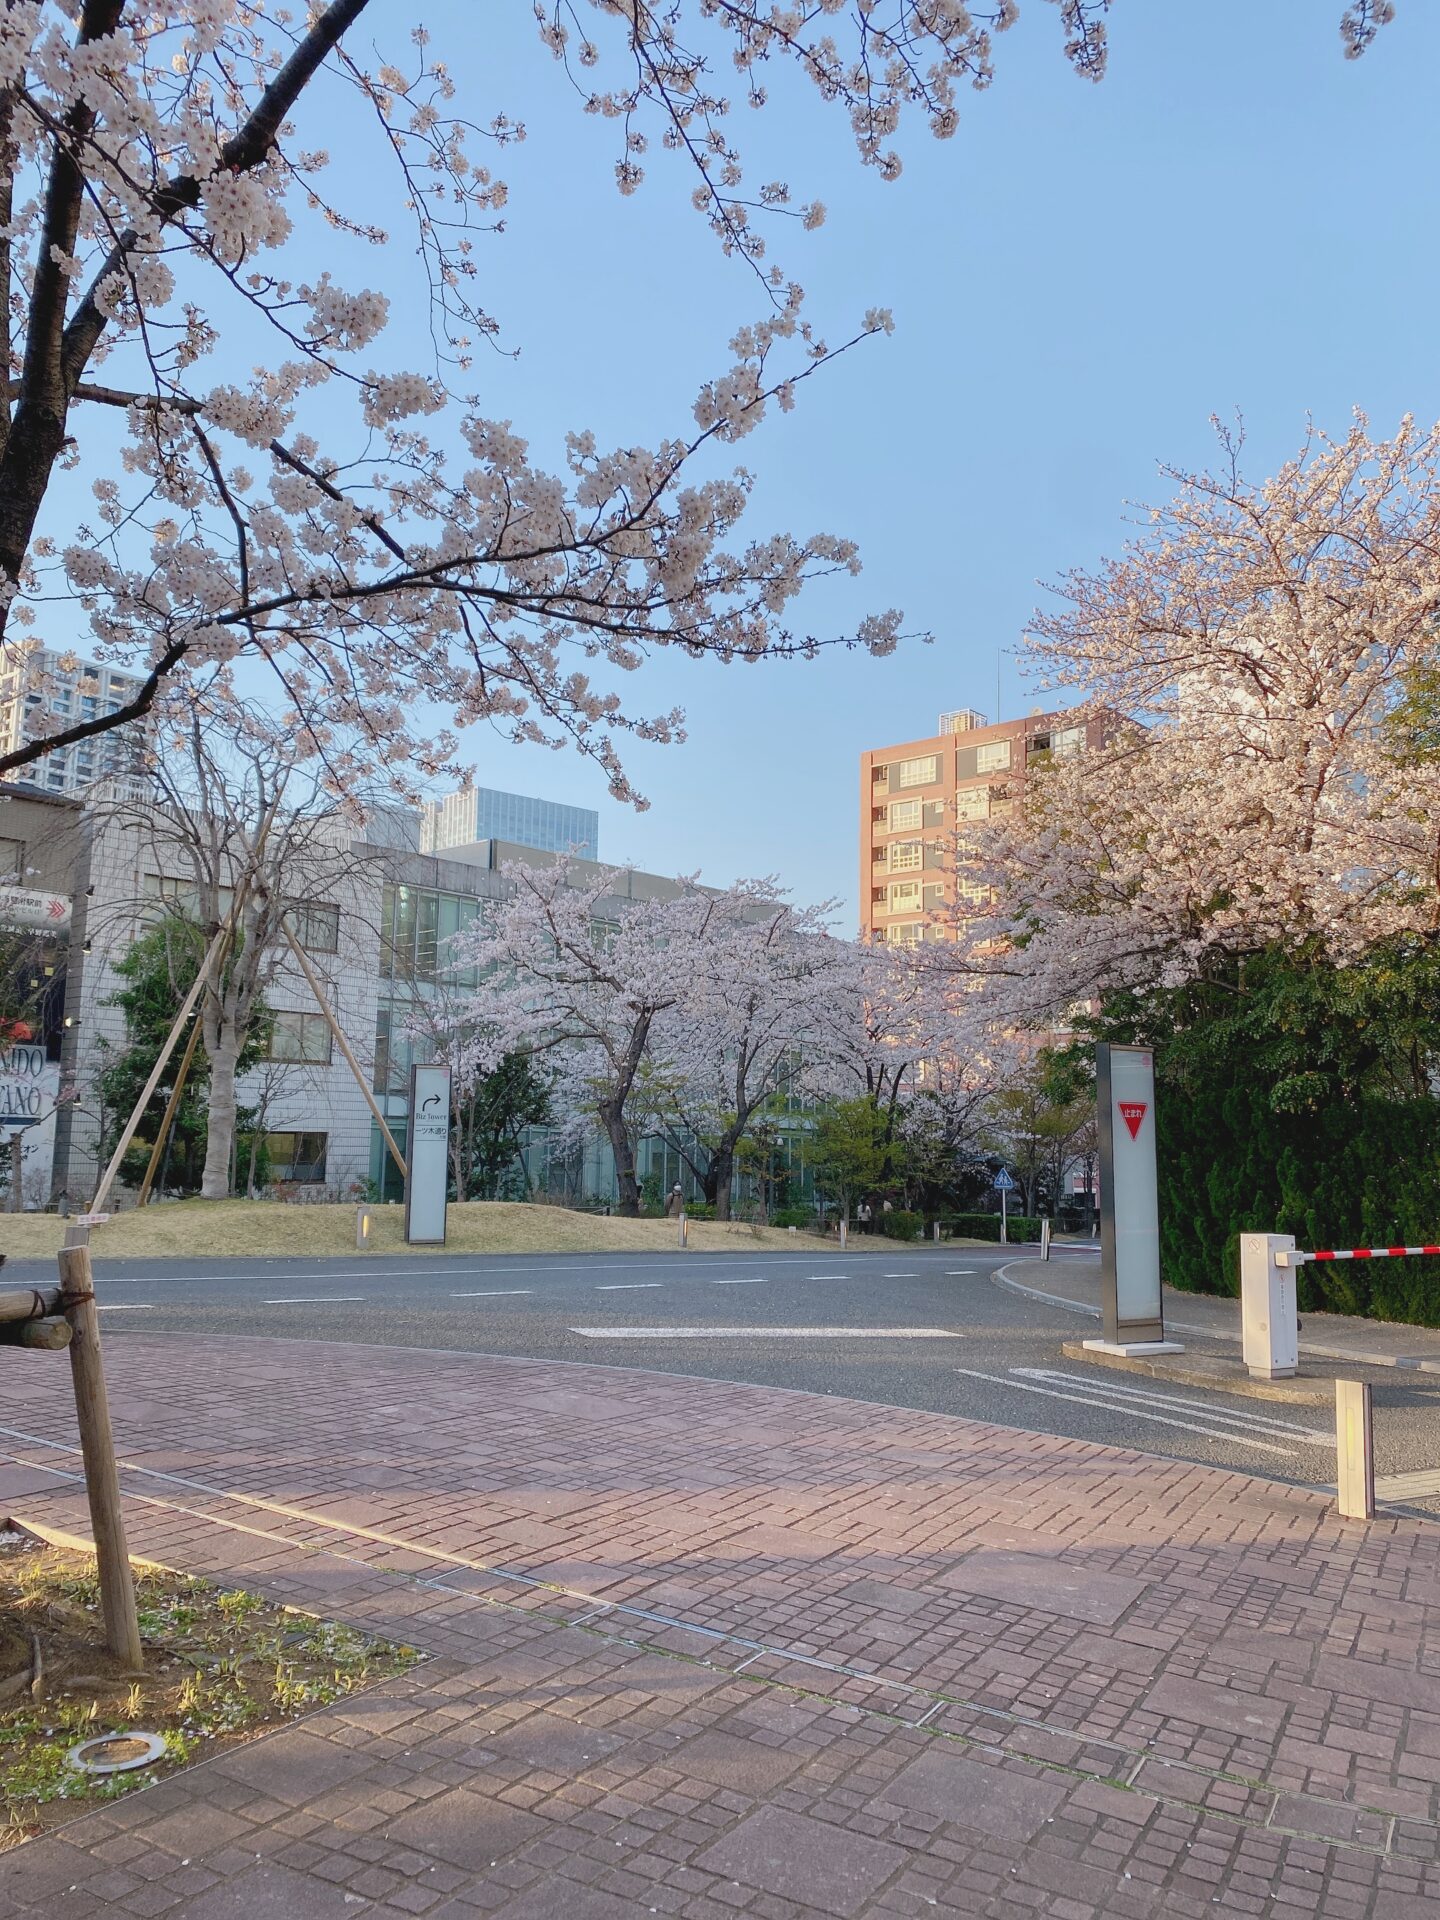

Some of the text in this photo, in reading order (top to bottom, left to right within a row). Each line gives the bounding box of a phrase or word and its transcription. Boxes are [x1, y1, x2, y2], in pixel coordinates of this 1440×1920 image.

[416, 1112, 447, 1120] Biz Tower
[1124, 1108, 1142, 1118] 止まれ
[415, 1127, 447, 1135] 一ツ木通り
